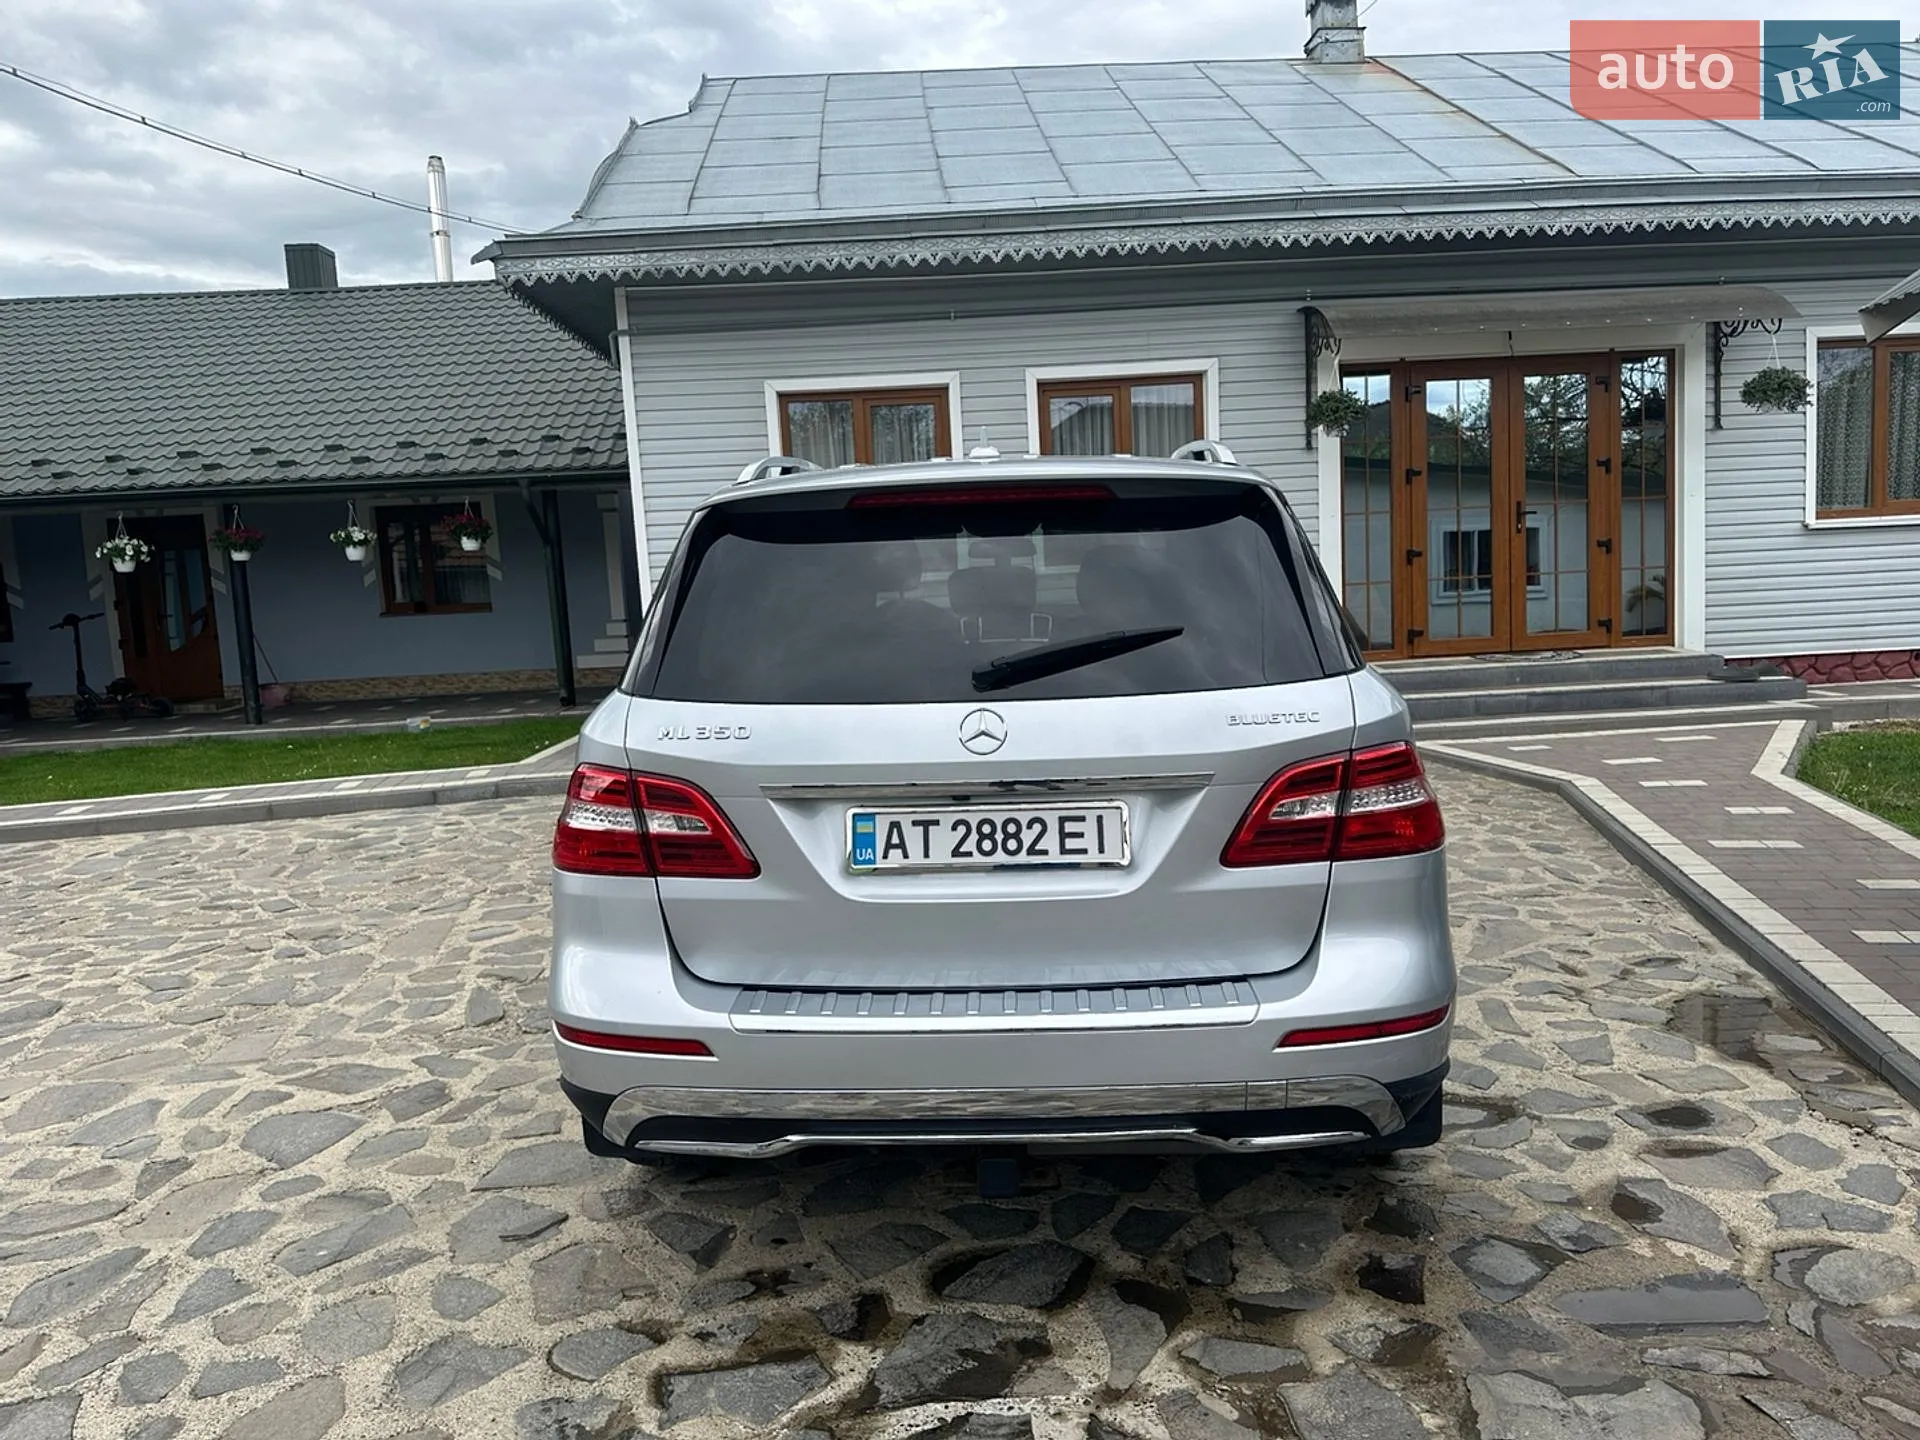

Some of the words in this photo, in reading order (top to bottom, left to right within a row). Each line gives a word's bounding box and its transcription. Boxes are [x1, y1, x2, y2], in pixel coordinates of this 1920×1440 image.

[1226, 711, 1321, 726] BLUETEC
[657, 724, 690, 740] ML
[695, 724, 751, 740] 350
[881, 819, 940, 860] AT
[950, 817, 1049, 858] 2882
[1058, 815, 1105, 855] EI
[856, 849, 875, 861] UA
